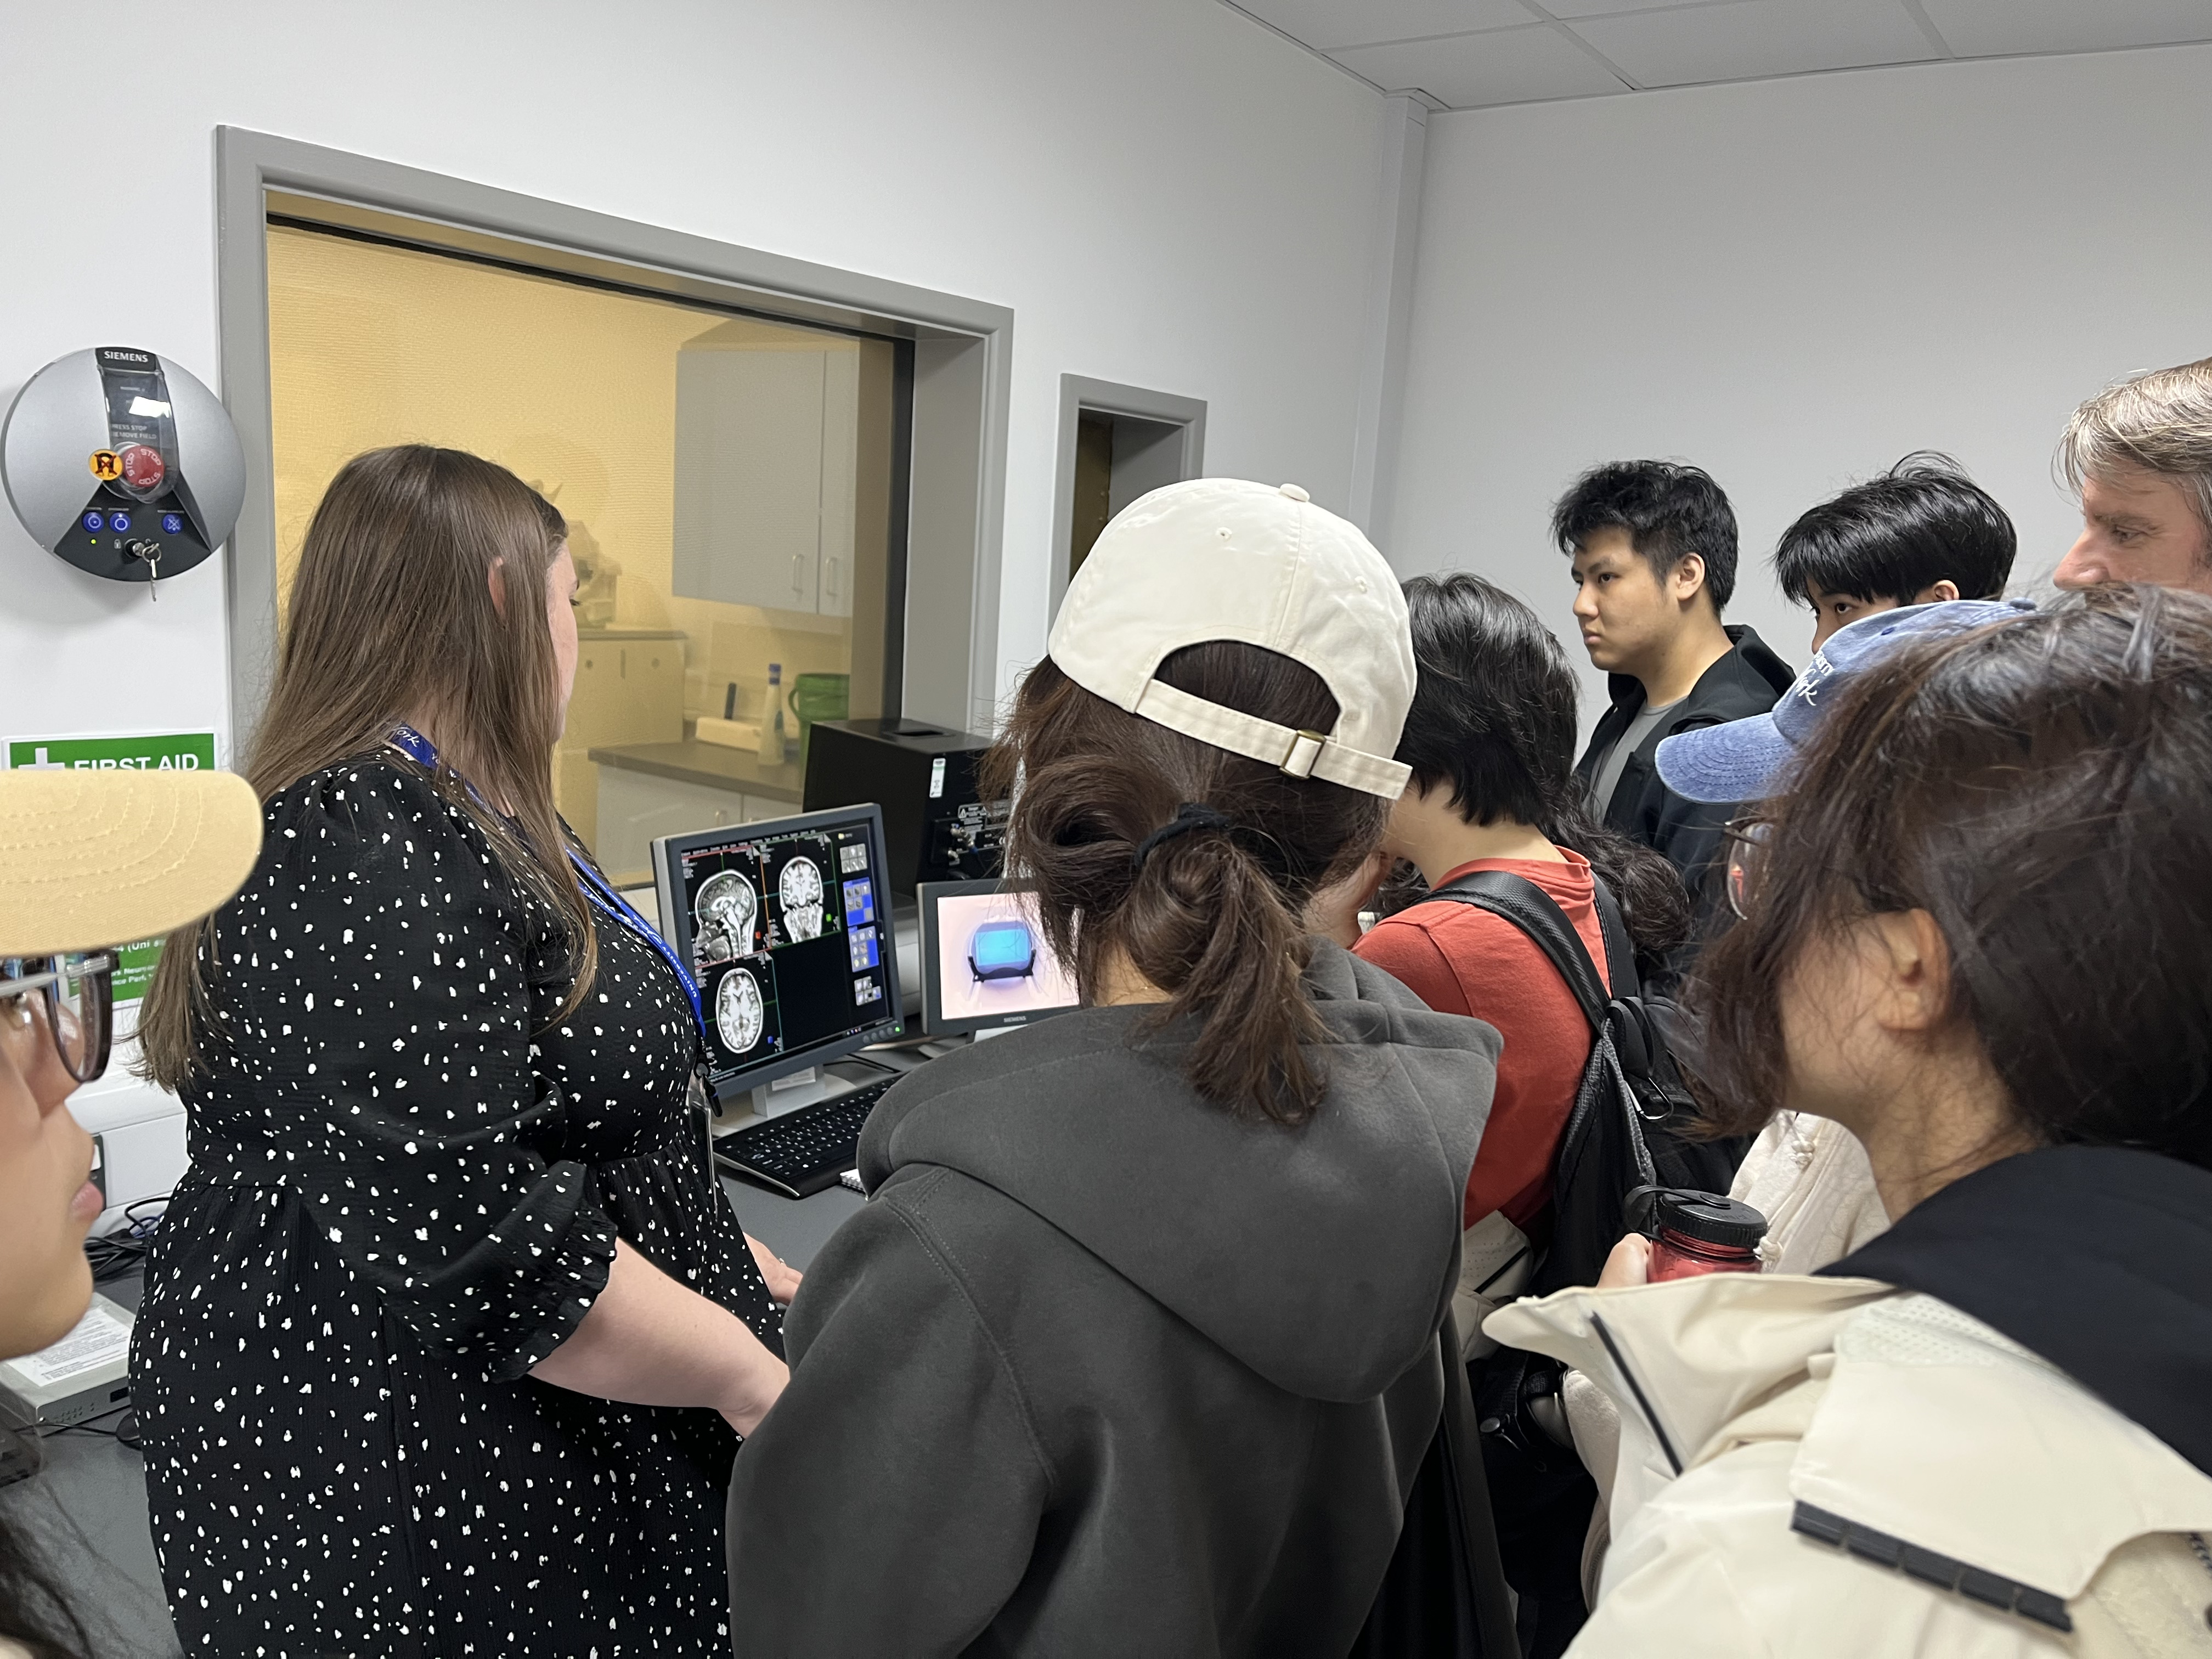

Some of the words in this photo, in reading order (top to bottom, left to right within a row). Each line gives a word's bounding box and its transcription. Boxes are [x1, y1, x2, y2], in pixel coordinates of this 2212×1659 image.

[104, 351, 148, 362] SIEMENS
[140, 448, 161, 466] STOP
[125, 453, 136, 477] STOP
[138, 472, 161, 484] STOP
[159, 753, 199, 771] AID
[127, 940, 150, 953] (Uni
